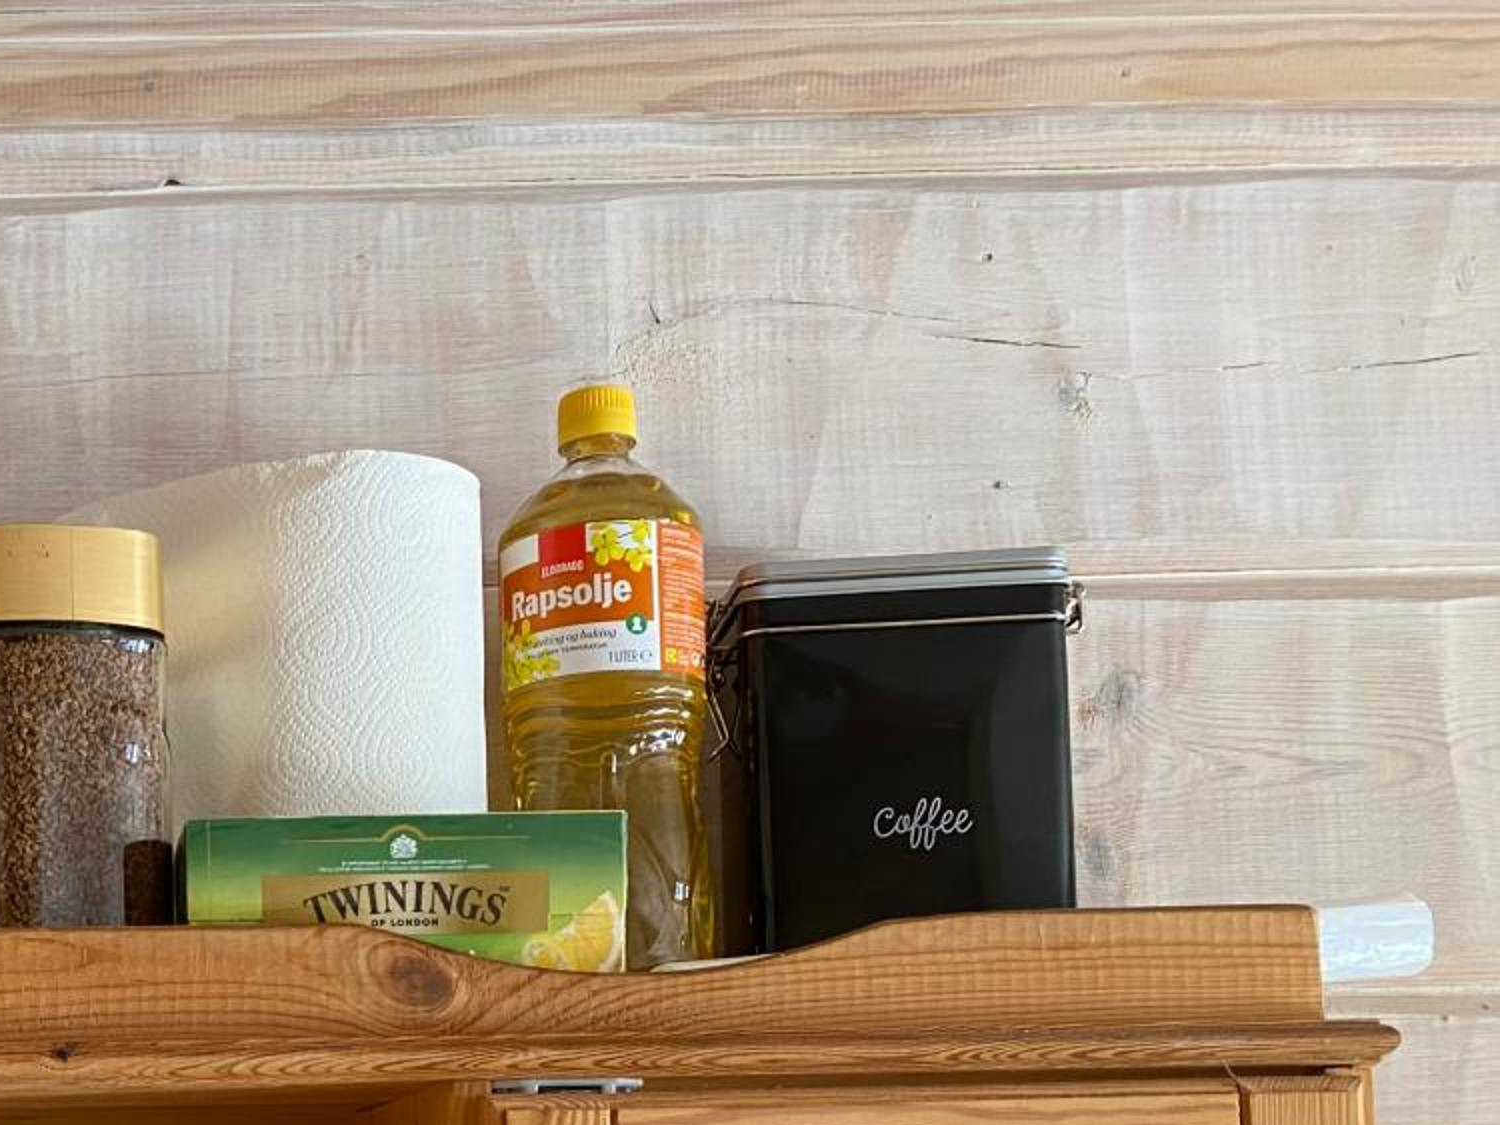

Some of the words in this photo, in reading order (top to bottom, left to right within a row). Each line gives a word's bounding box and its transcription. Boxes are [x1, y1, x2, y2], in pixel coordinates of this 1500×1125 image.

[512, 571, 633, 622] Rapsolje
[873, 797, 973, 850] Coffee
[303, 880, 507, 926] TWININGS
[371, 919, 385, 928] OF
[389, 918, 439, 928] LONDON
